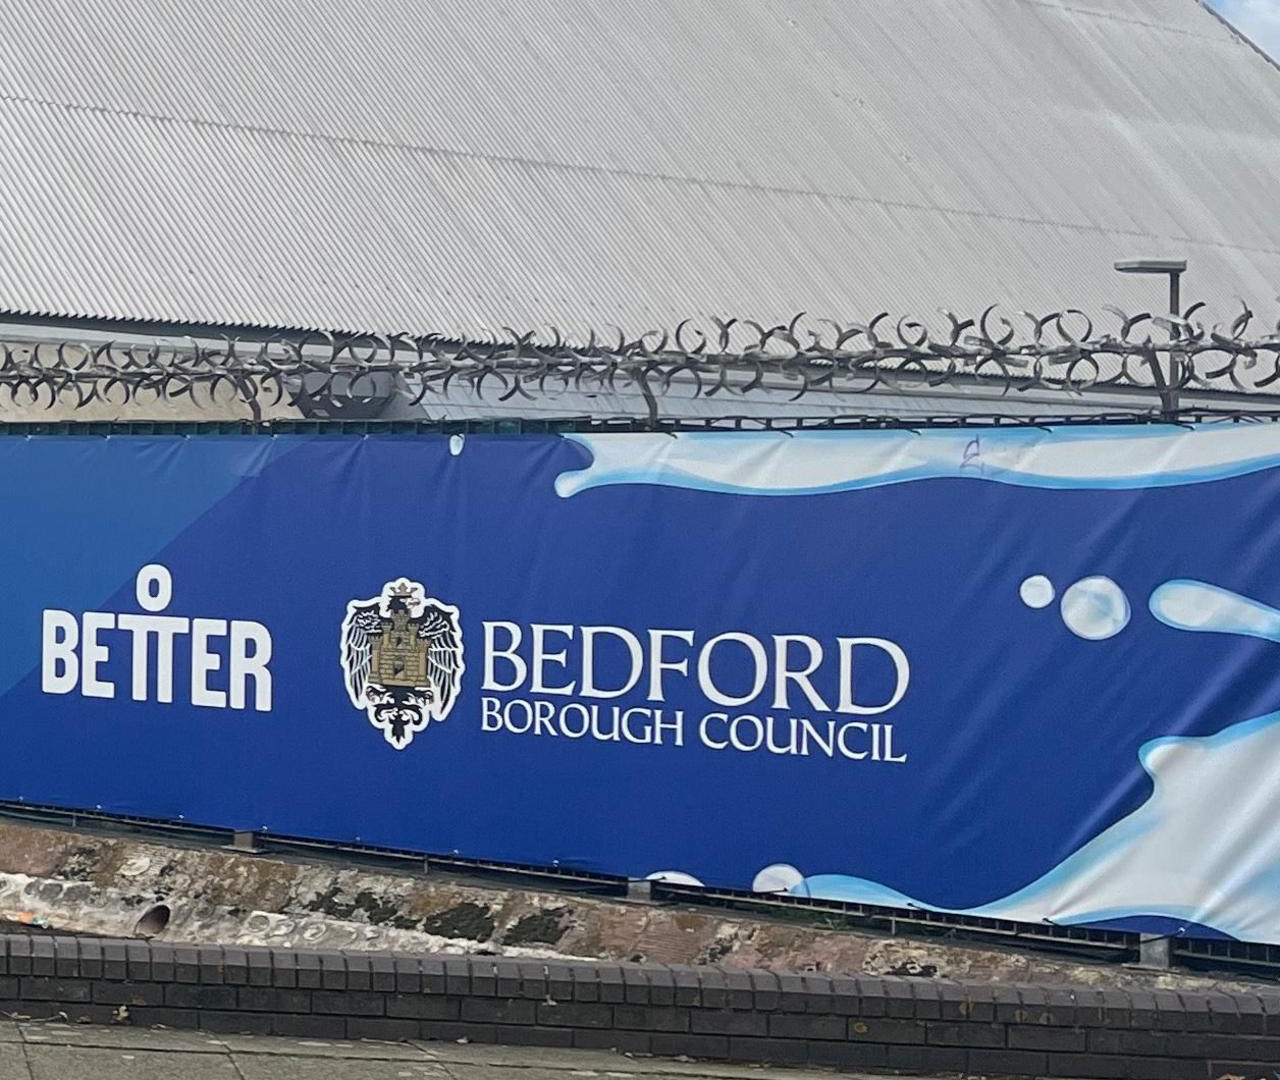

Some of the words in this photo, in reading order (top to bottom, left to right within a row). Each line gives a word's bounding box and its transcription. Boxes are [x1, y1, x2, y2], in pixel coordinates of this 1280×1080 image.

[41, 609, 272, 712] BETTER
[481, 621, 910, 715] BEDFORD
[481, 697, 685, 746] BOROUGH
[699, 712, 907, 763] COUNCIL
